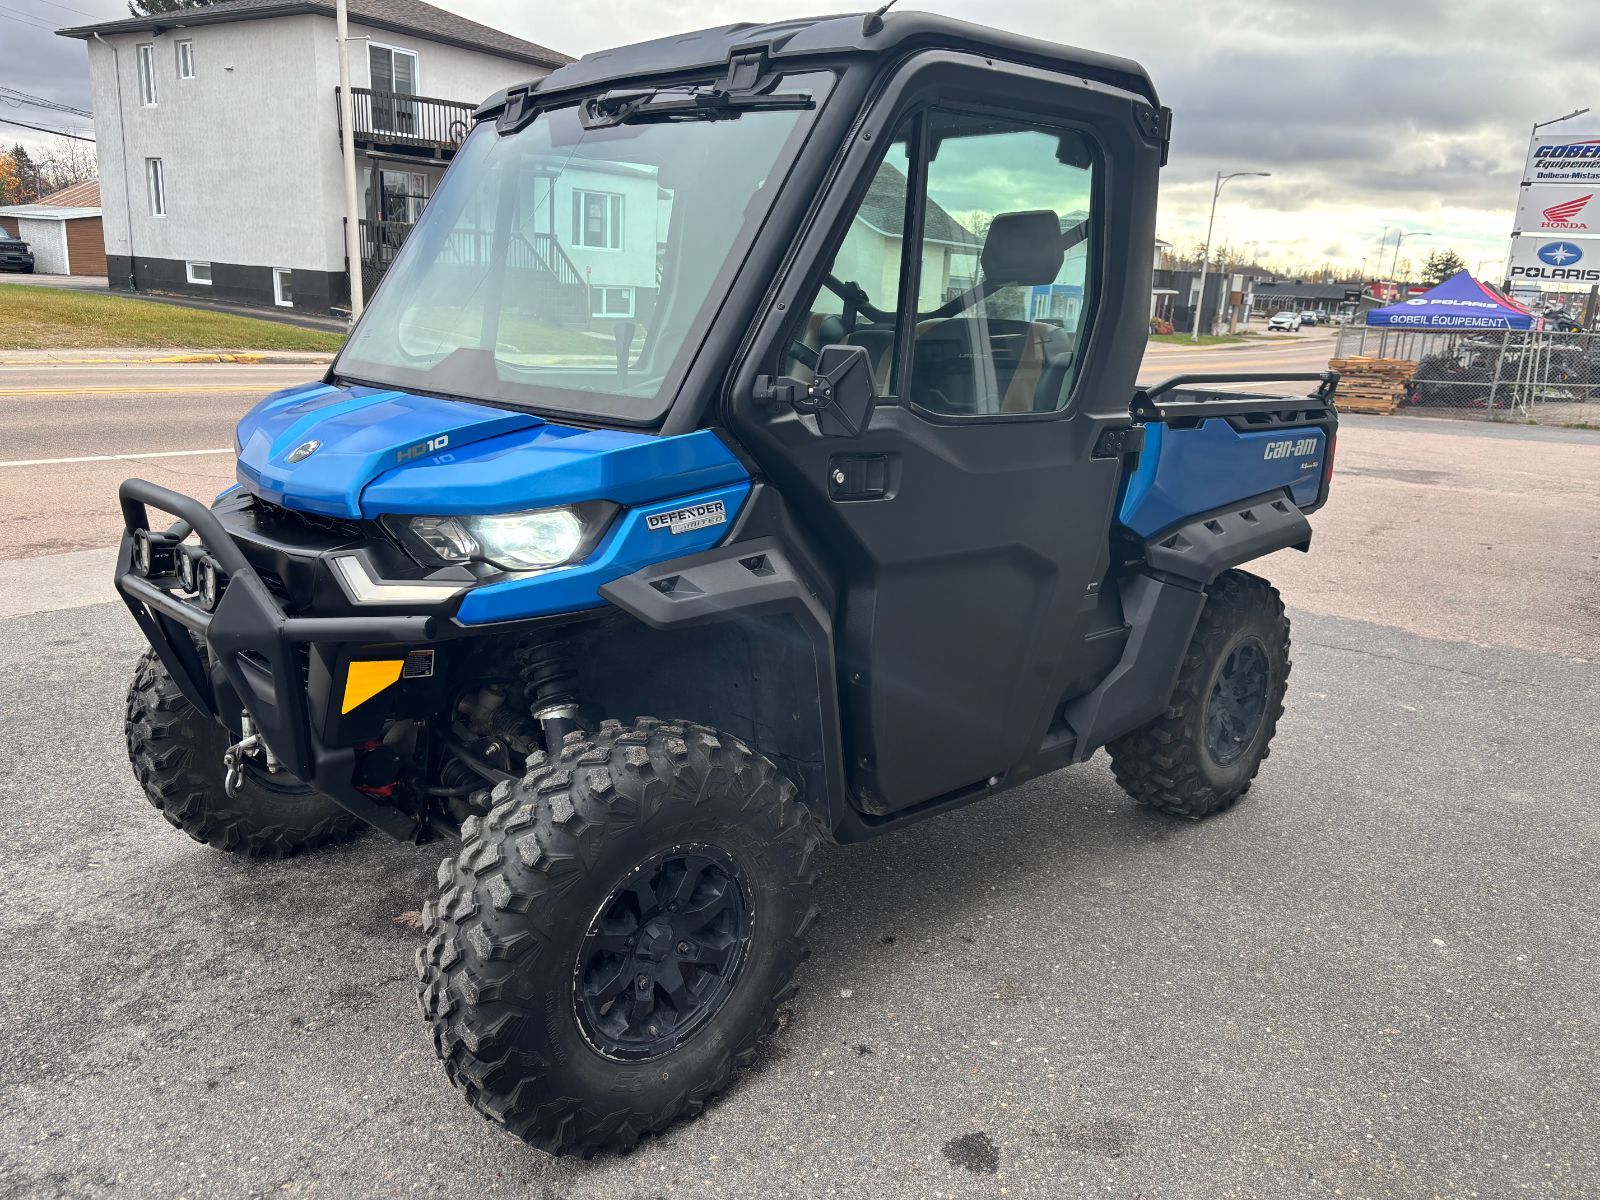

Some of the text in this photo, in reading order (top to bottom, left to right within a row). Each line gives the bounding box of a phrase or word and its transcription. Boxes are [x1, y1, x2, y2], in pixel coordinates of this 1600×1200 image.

[1533, 145, 1600, 158] GOBEI
[1534, 159, 1600, 170] Equipeme
[1540, 221, 1588, 230] HONDA
[1510, 266, 1600, 281] POLARIS
[1430, 299, 1499, 309] POLARIS
[1390, 314, 1504, 327] GOBEIL ÉQUIPEMENT
[397, 434, 450, 463] HD10
[1263, 438, 1318, 460] can-am
[649, 502, 723, 526] DEFENDER
